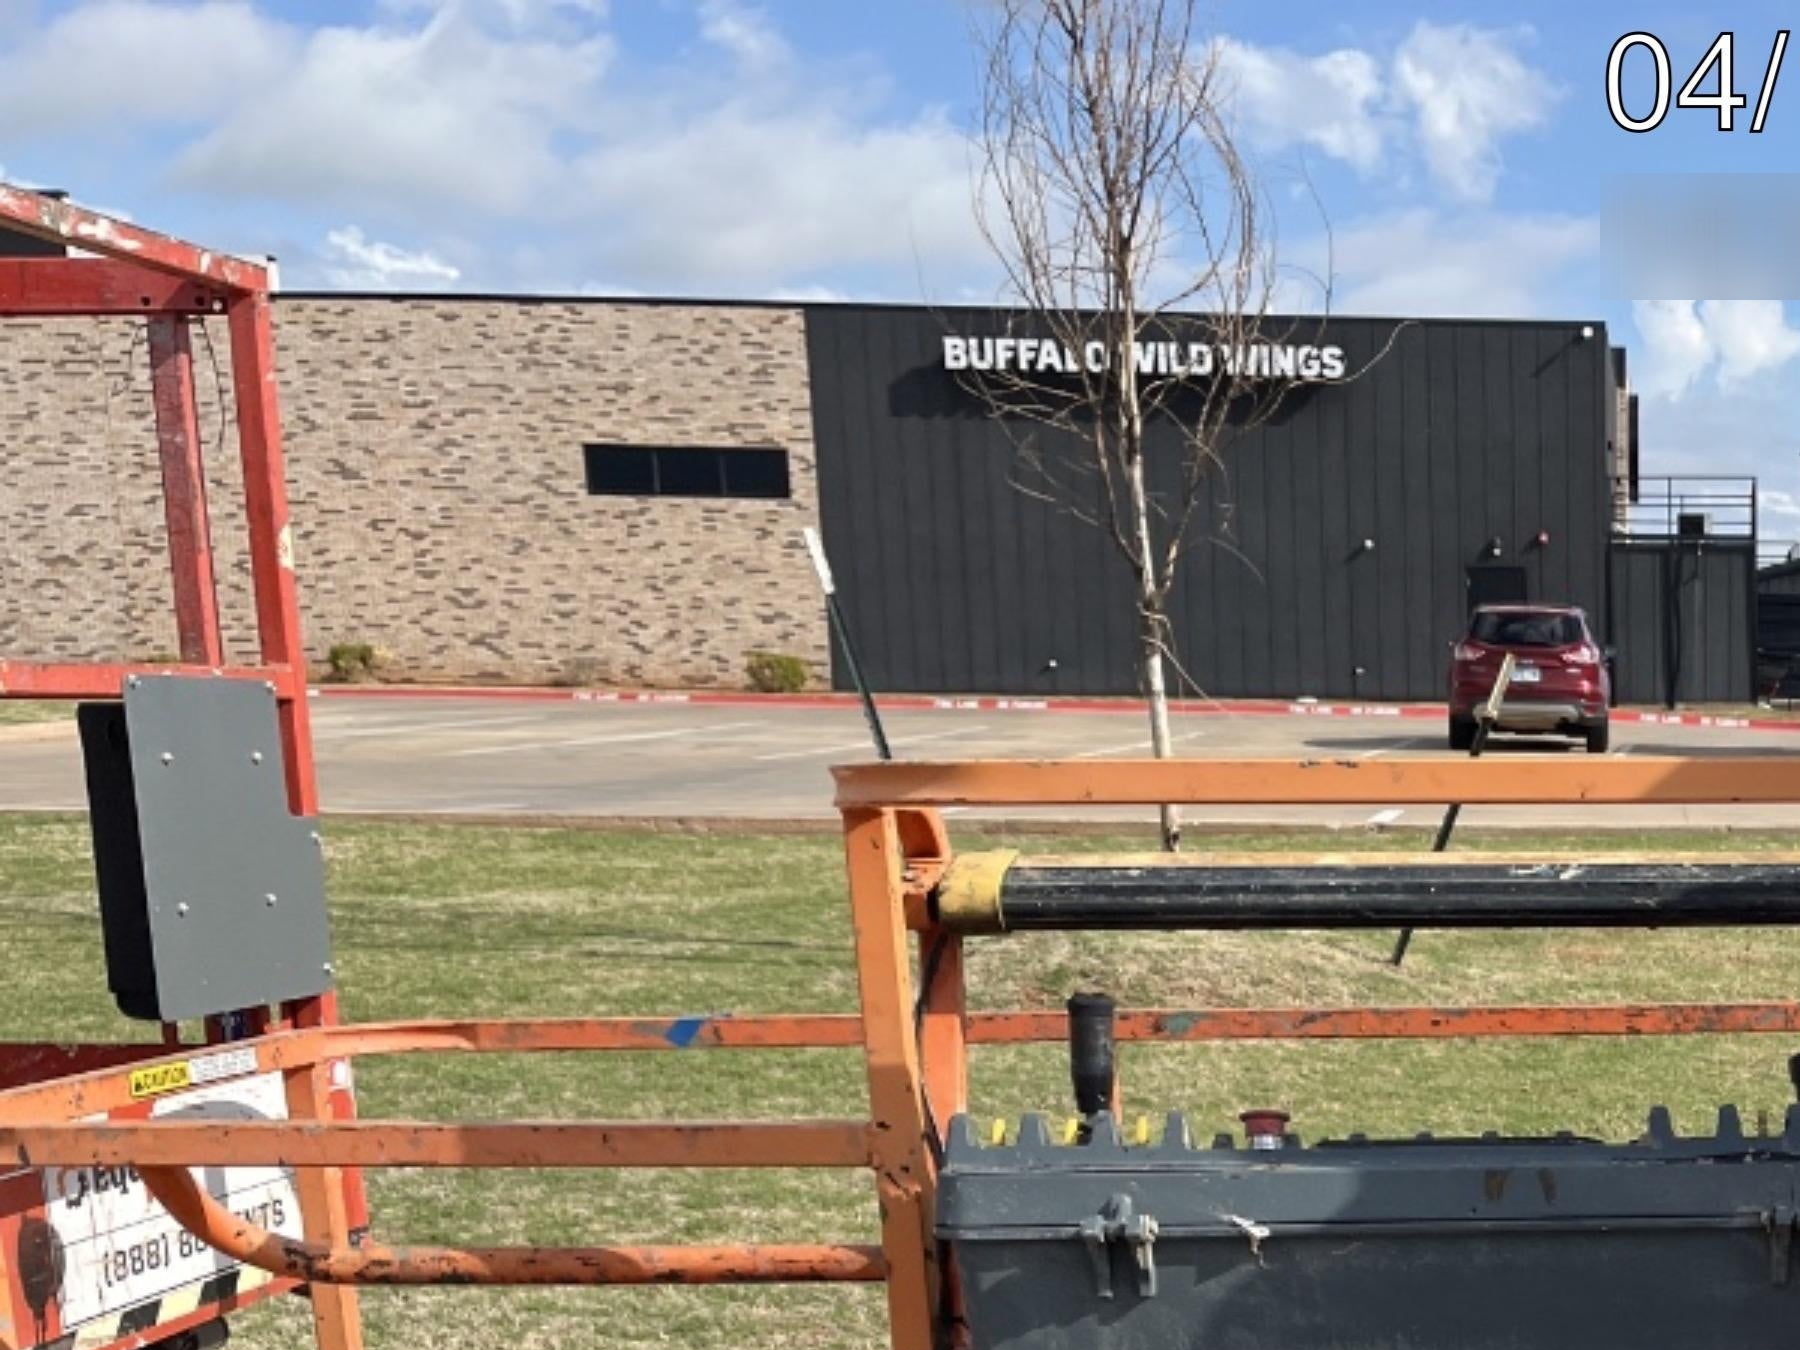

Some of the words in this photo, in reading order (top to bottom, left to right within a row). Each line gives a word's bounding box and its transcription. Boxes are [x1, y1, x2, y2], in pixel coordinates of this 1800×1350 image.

[943, 336, 1108, 372] BUFFALO
[1120, 340, 1213, 377] WILD
[1222, 343, 1345, 380] WINGS
[103, 1232, 170, 1287] (888)
